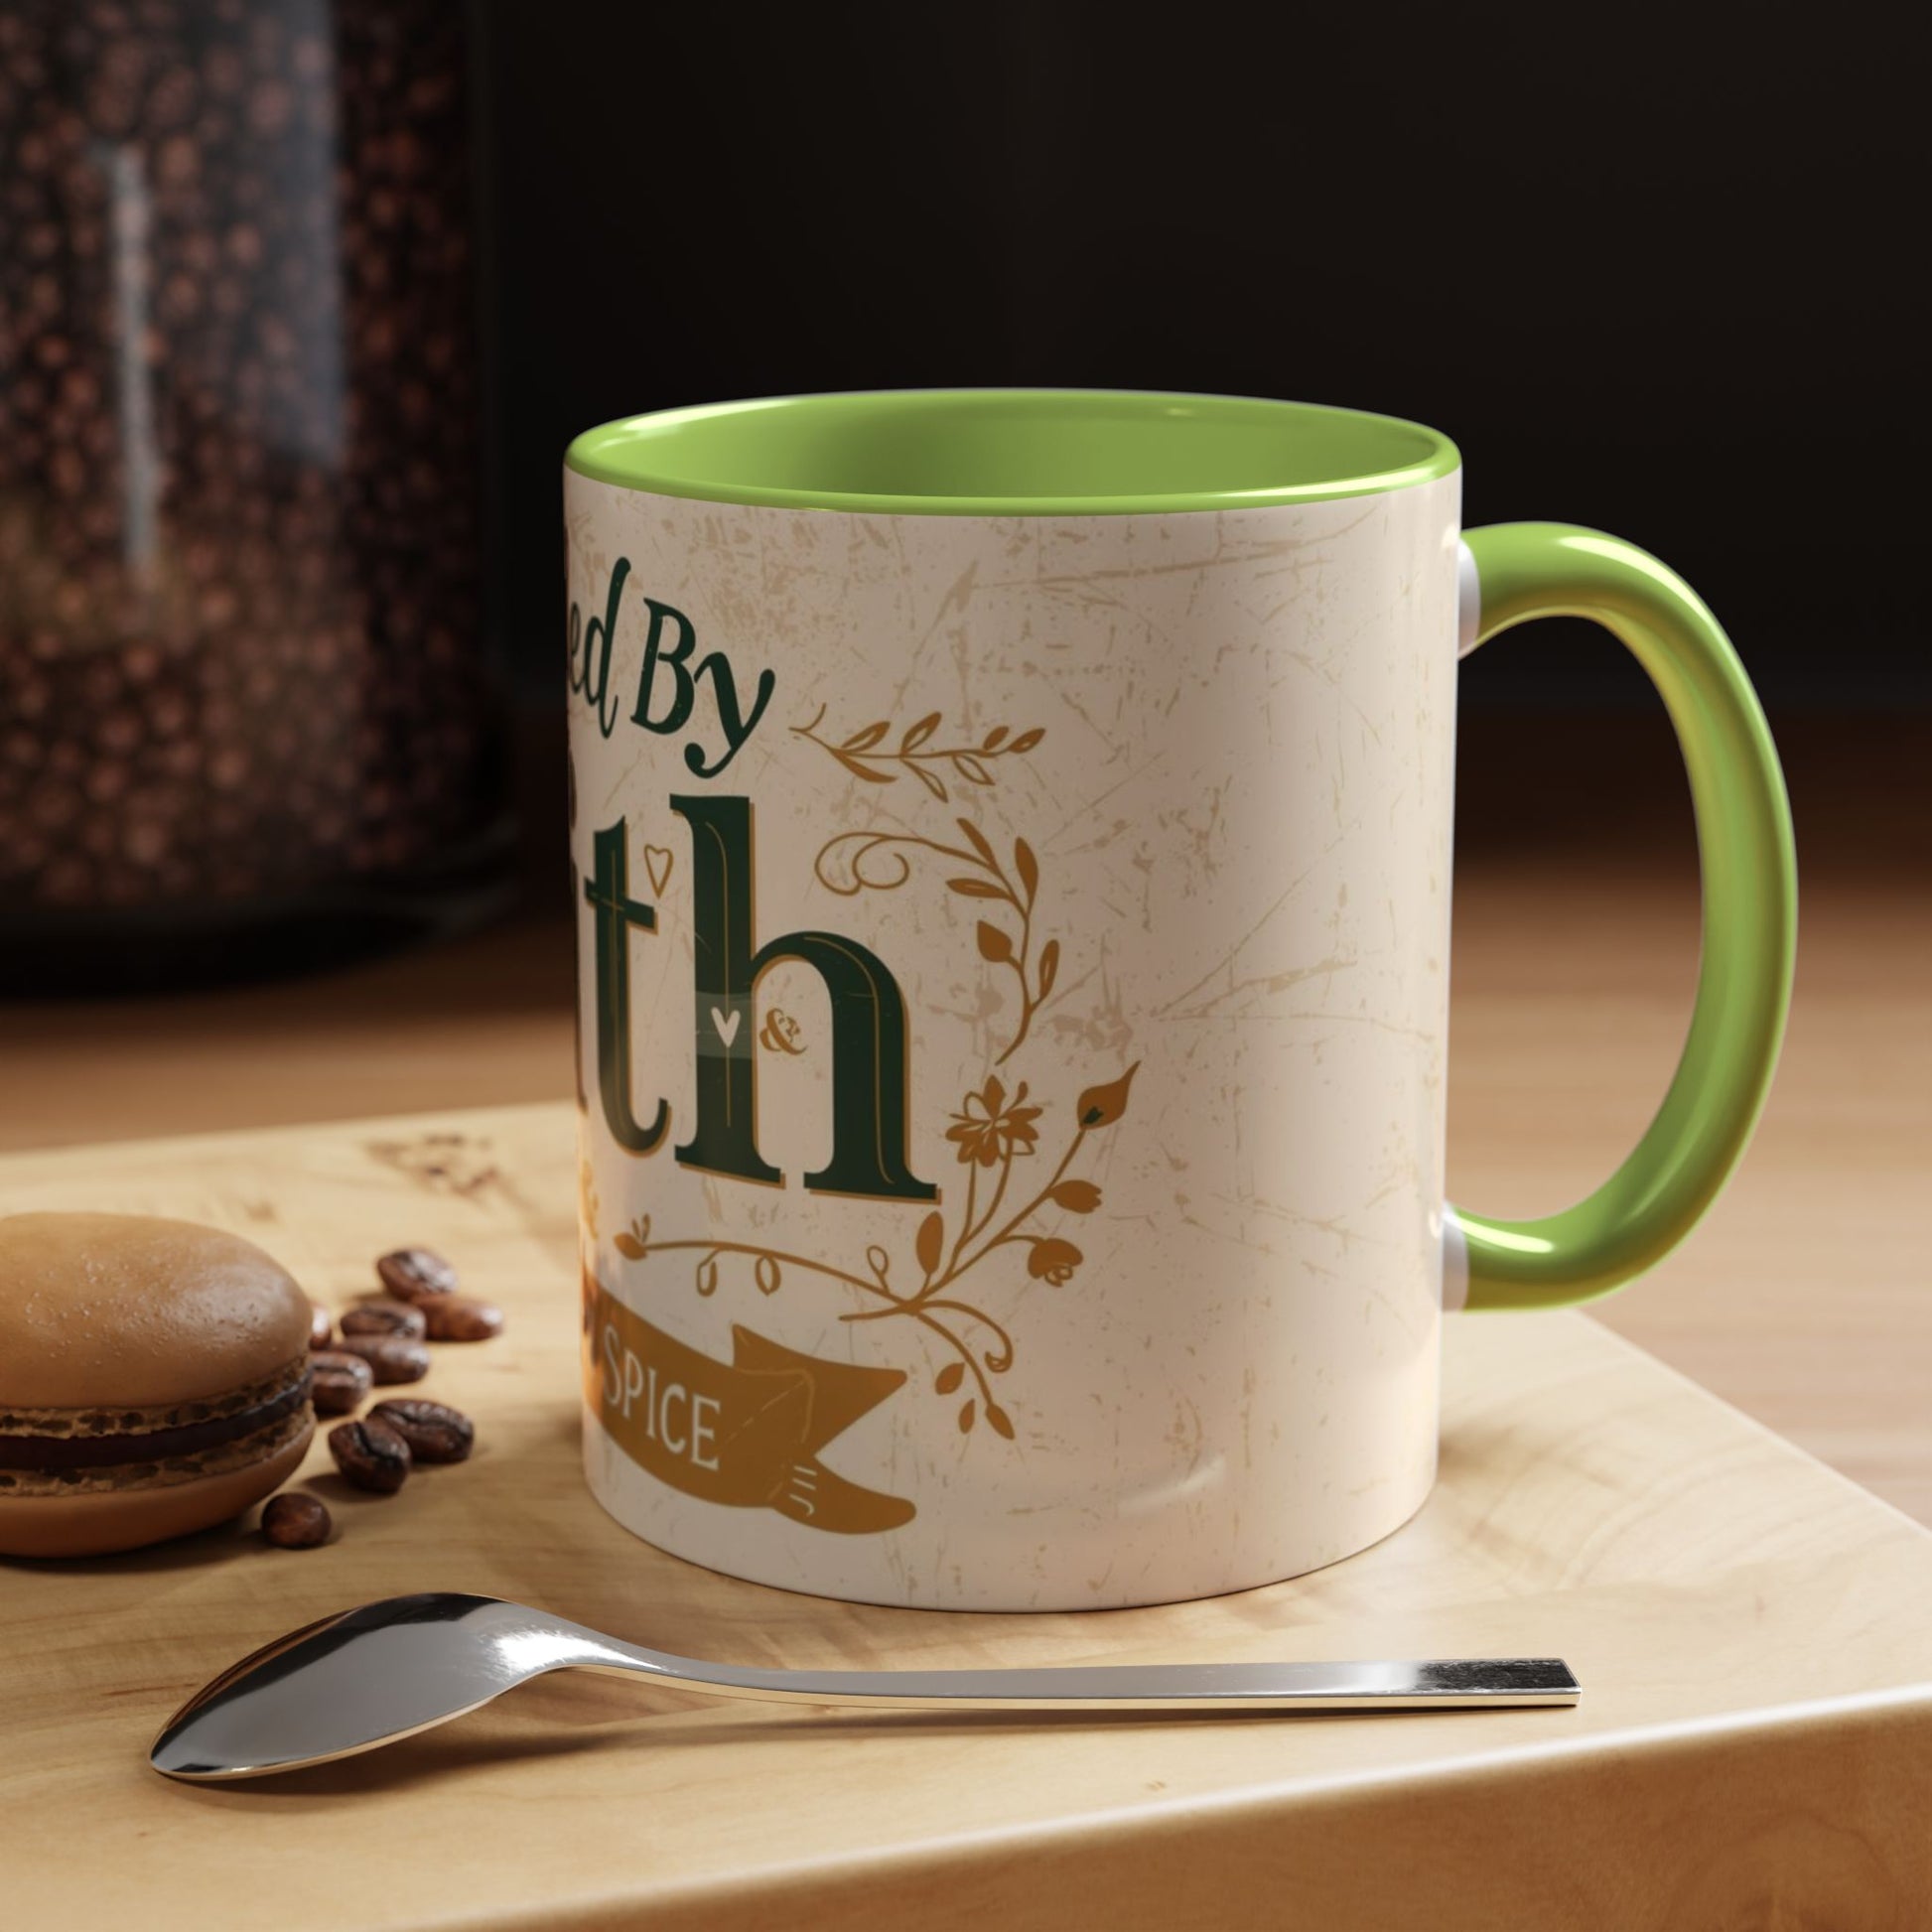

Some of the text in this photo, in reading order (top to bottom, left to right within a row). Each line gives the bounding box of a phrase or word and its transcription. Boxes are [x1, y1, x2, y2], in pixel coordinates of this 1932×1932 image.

[629, 597, 775, 778] By
[569, 747, 942, 1205] th
[603, 1322, 721, 1471] SPICE
